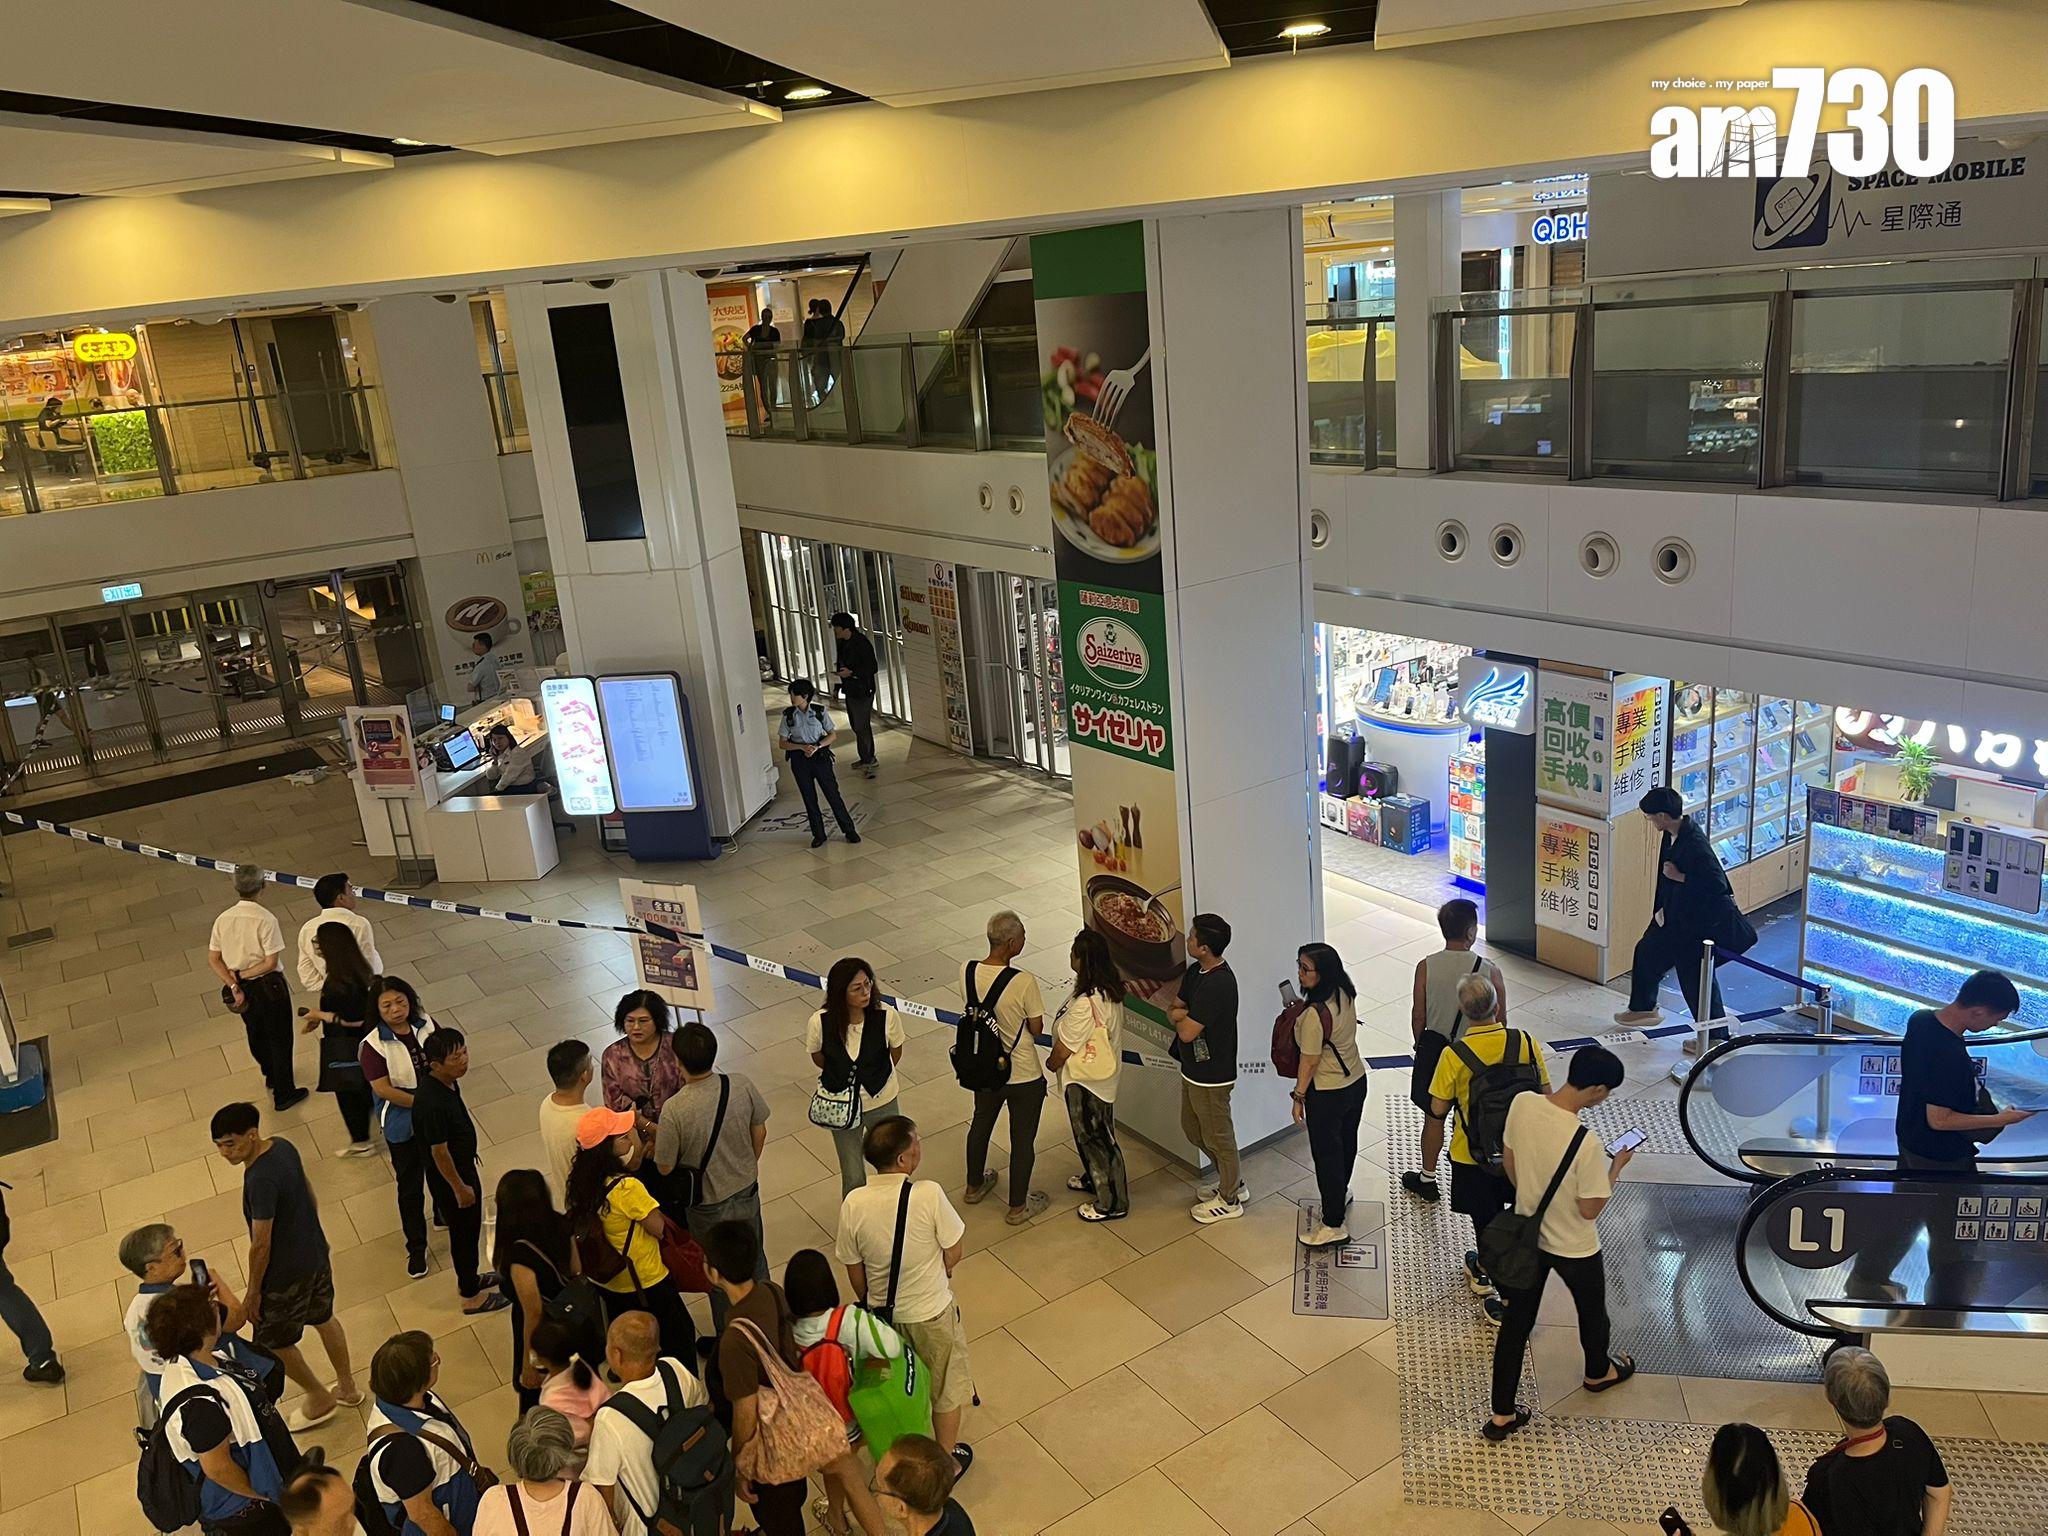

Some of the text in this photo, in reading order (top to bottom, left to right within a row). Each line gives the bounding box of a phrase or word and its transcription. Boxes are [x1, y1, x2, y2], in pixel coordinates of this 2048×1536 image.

[1927, 157, 2027, 186] MOBILE
[1880, 200, 1963, 232] 星際通
[103, 587, 124, 600] EXIT
[1084, 633, 1143, 668] Saizeriya
[1072, 702, 1166, 758] サイゼリヤ
[1543, 697, 1591, 732] 高價
[1616, 705, 1647, 735] 專業
[1543, 726, 1590, 761] 回收
[1614, 737, 1646, 768] 手機
[1542, 756, 1590, 791] 手機
[1613, 767, 1645, 797] 維修
[1540, 832, 1580, 862] 專業
[1540, 861, 1580, 892] 手機
[1540, 888, 1580, 918] 維修
[1788, 1206, 1846, 1252] L1
